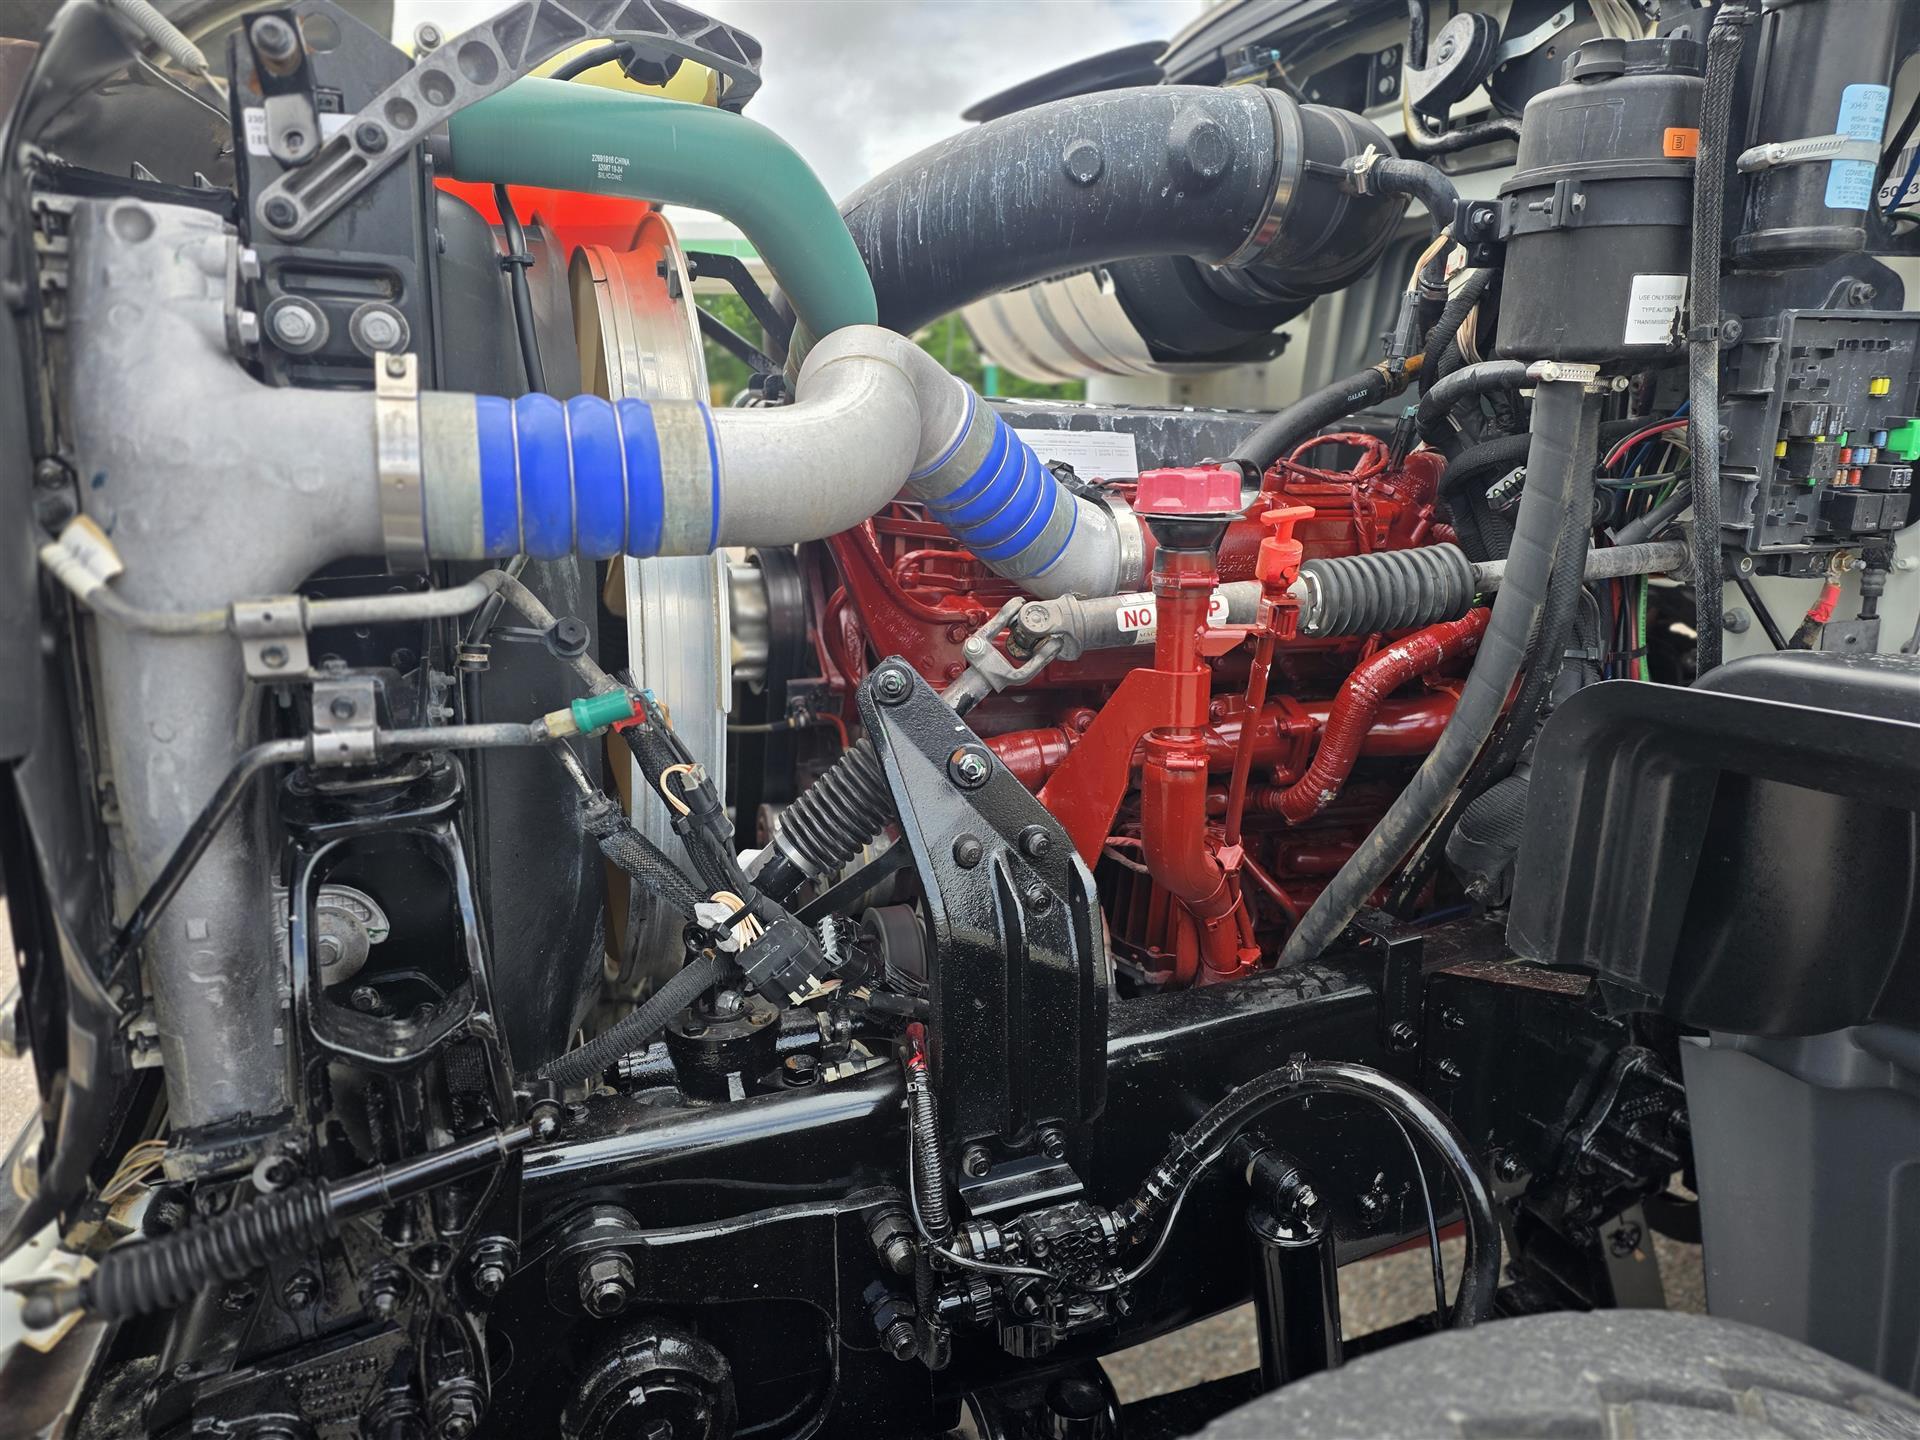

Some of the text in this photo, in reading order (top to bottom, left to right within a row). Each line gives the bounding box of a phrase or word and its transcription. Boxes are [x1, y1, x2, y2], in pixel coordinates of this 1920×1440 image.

[615, 156, 631, 166] CHINA
[597, 171, 623, 181] SILICONE
[1880, 182, 1919, 198] 503
[1347, 389, 1368, 401] GALAXY
[1124, 608, 1152, 628] NO
